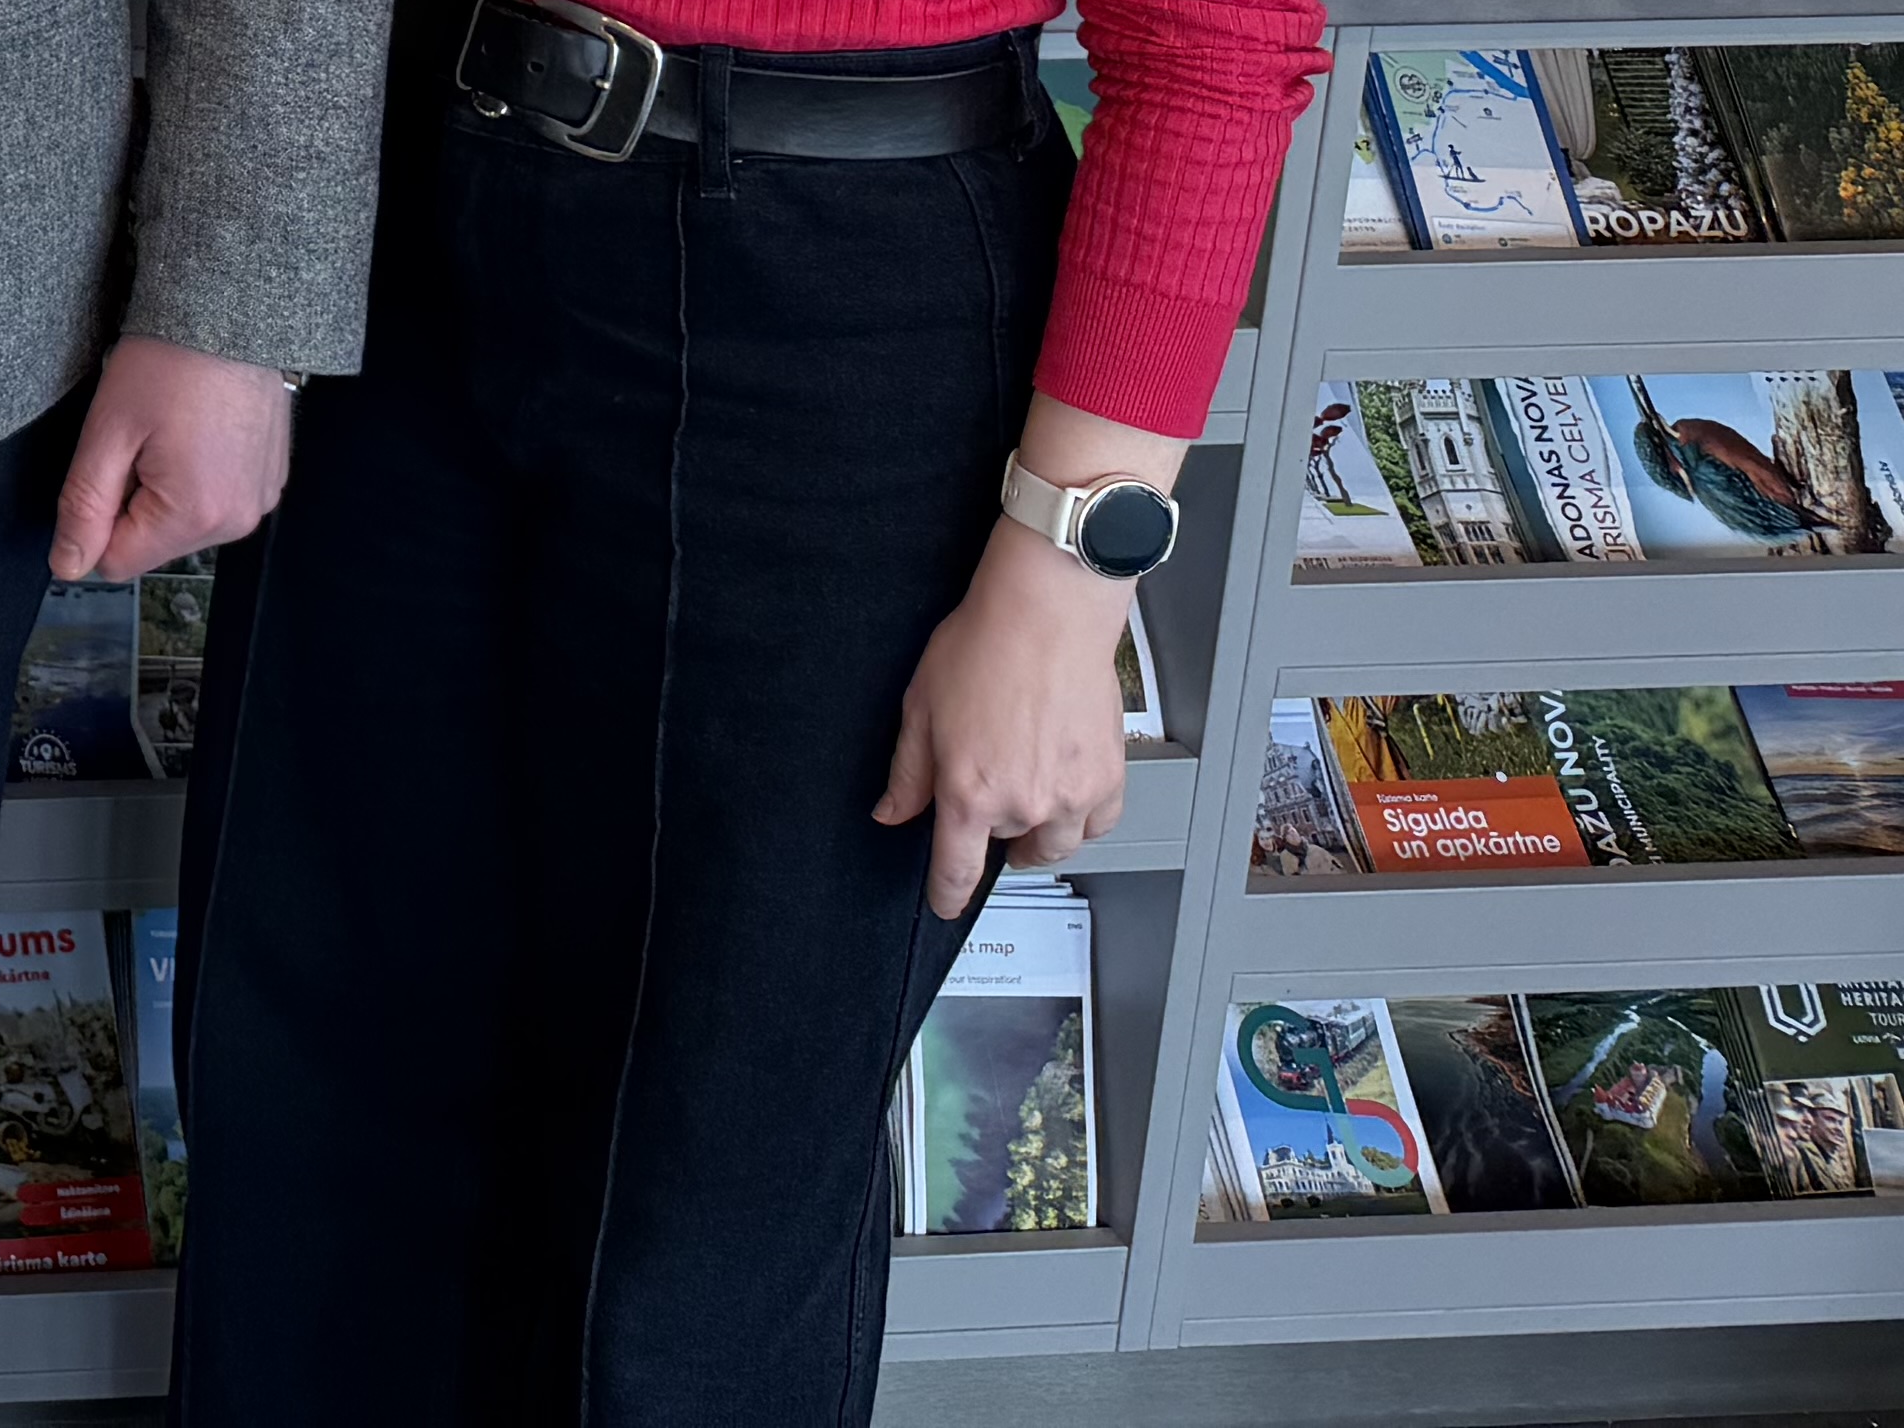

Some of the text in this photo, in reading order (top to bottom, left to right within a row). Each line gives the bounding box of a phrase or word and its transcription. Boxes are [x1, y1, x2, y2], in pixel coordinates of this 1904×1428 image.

[1543, 376, 1590, 464] CEĻVE
[1382, 806, 1489, 838] Sigulda
[1393, 831, 1562, 862] un apkārtne
[978, 941, 1015, 957] map
[1841, 991, 1904, 1007] HERITA
